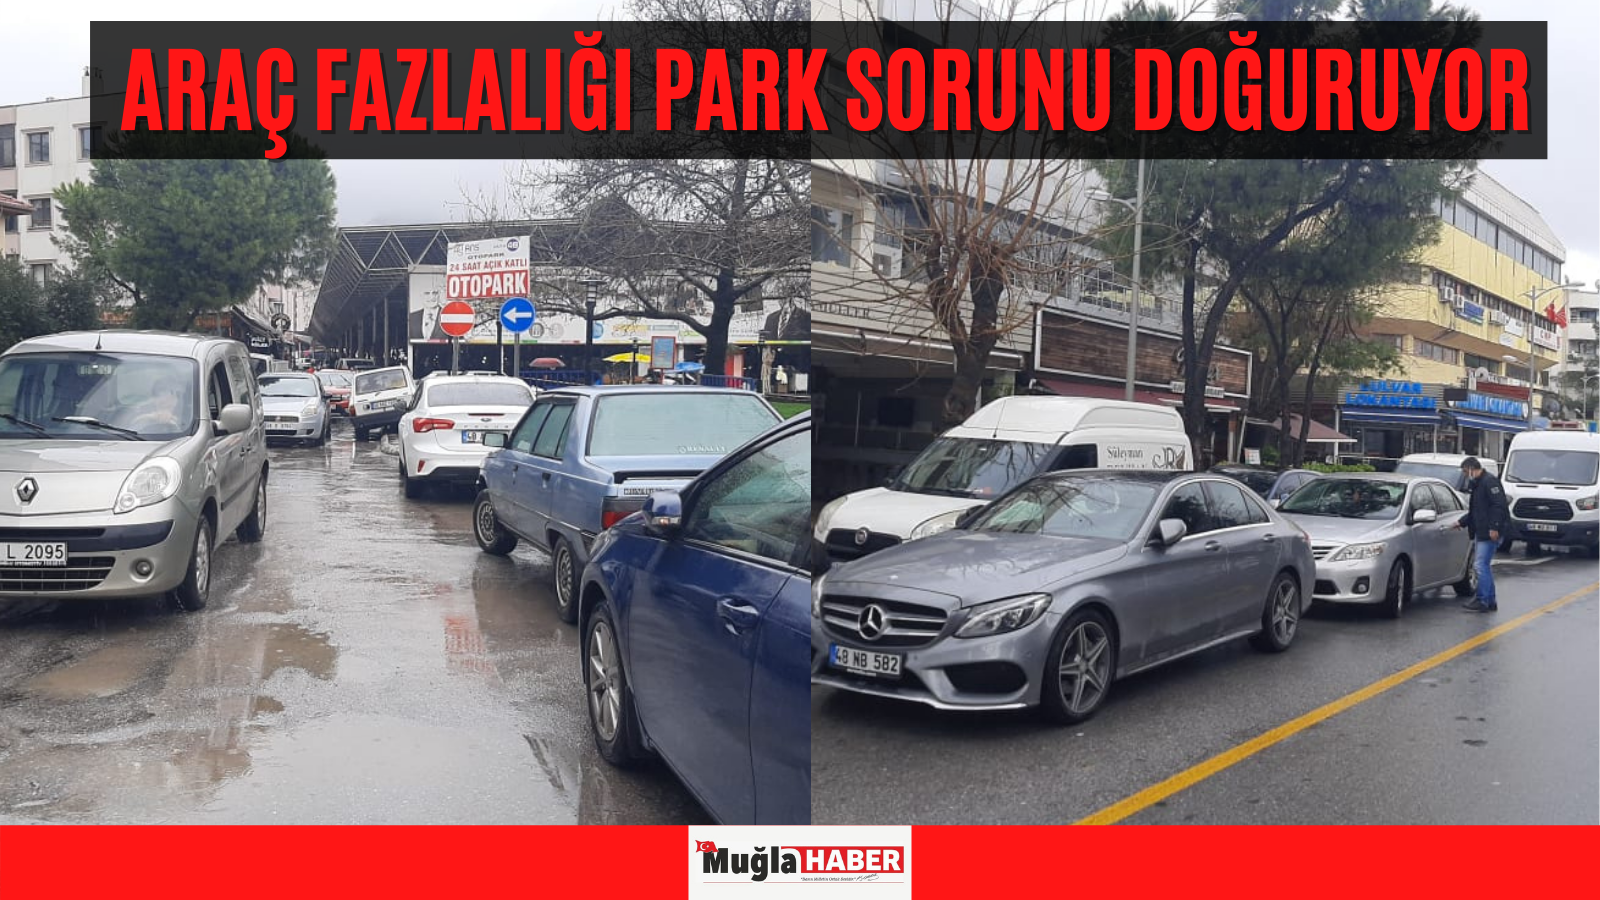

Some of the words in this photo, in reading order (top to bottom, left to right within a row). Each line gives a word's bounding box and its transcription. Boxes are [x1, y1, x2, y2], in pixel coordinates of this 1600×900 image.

[450, 263, 460, 272] 24
[463, 262, 481, 271] SAAT
[484, 260, 503, 272] AÇIK
[449, 272, 527, 297] OTOPARK
[7, 544, 16, 559] L
[24, 544, 64, 559] 2095
[836, 647, 848, 664] 48
[853, 651, 867, 668] NB
[874, 655, 899, 672] 582
